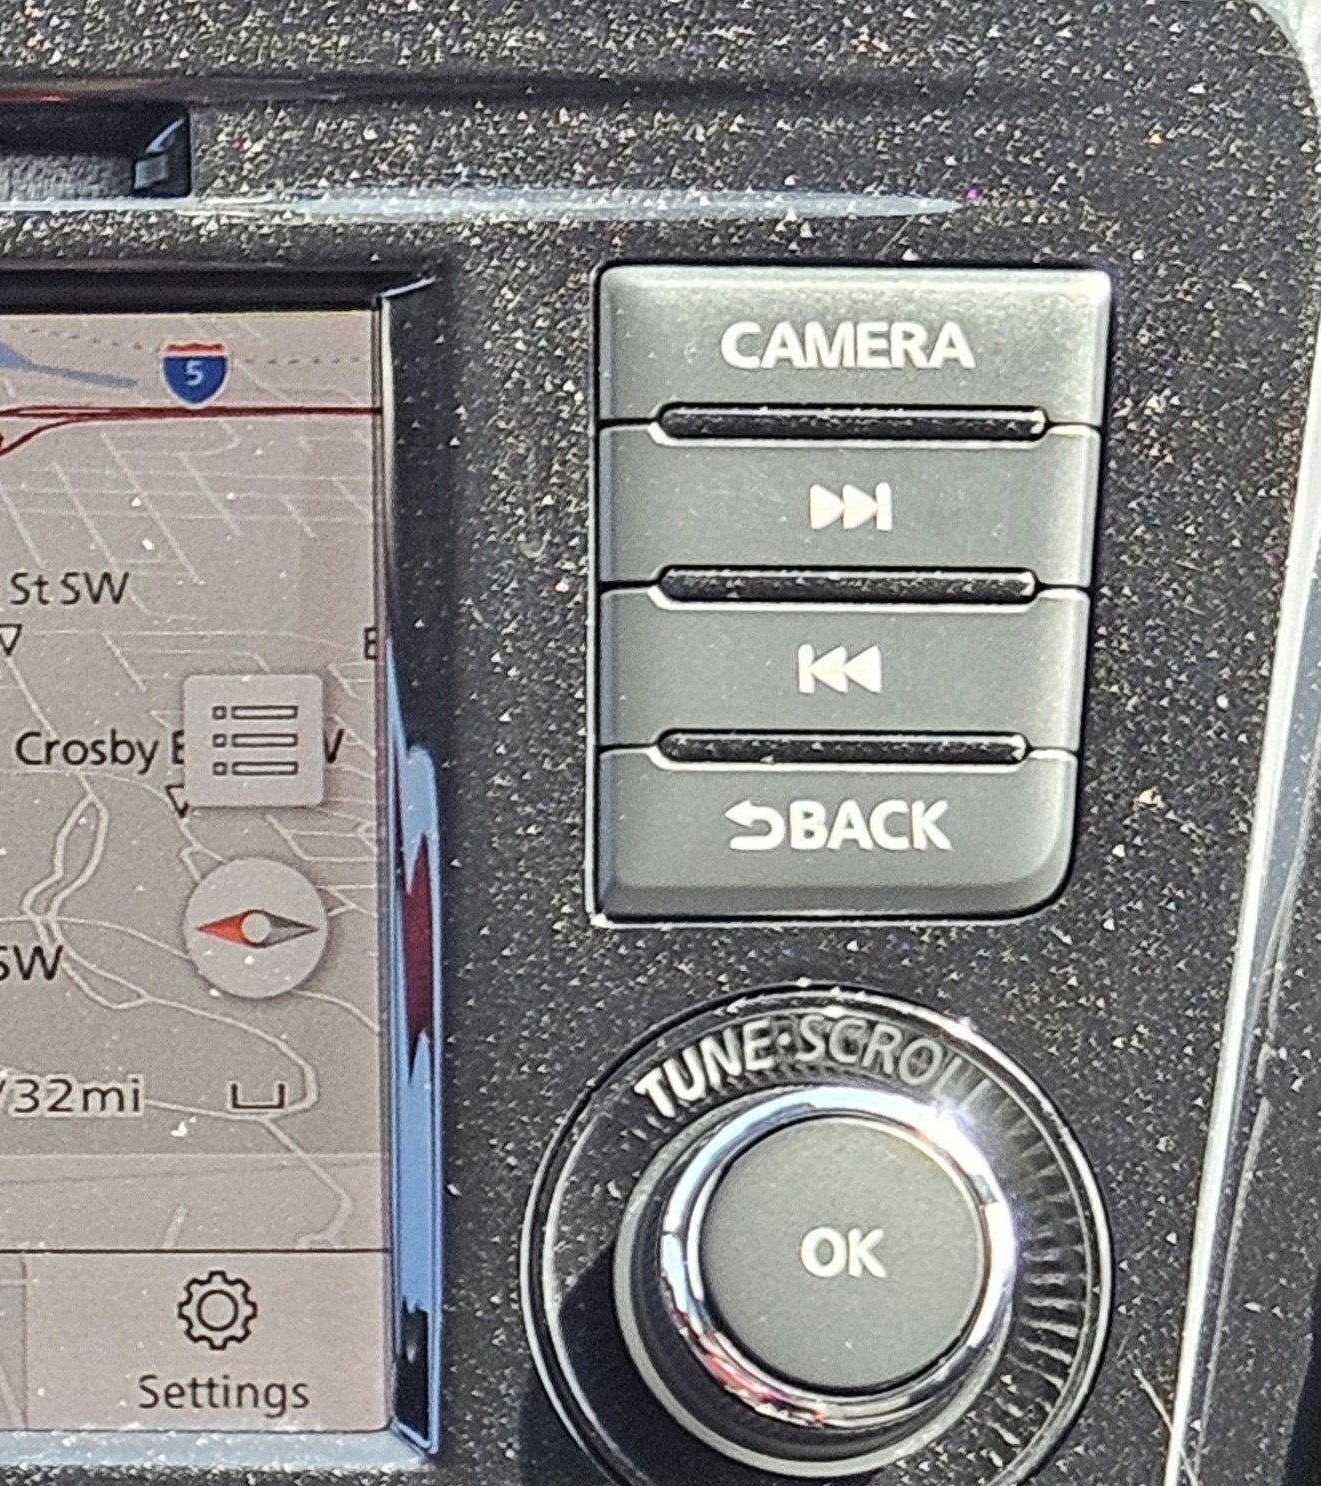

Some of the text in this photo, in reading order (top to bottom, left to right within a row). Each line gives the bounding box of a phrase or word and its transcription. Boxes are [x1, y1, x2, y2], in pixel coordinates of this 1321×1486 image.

[721, 321, 976, 368] CAMERA
[185, 360, 204, 386] 5
[5, 572, 50, 605] St
[61, 572, 129, 605] SW
[15, 730, 159, 774] Crosby
[789, 800, 952, 851] BACK
[800, 1227, 887, 1279] OK
[139, 1374, 310, 1417] Settings
